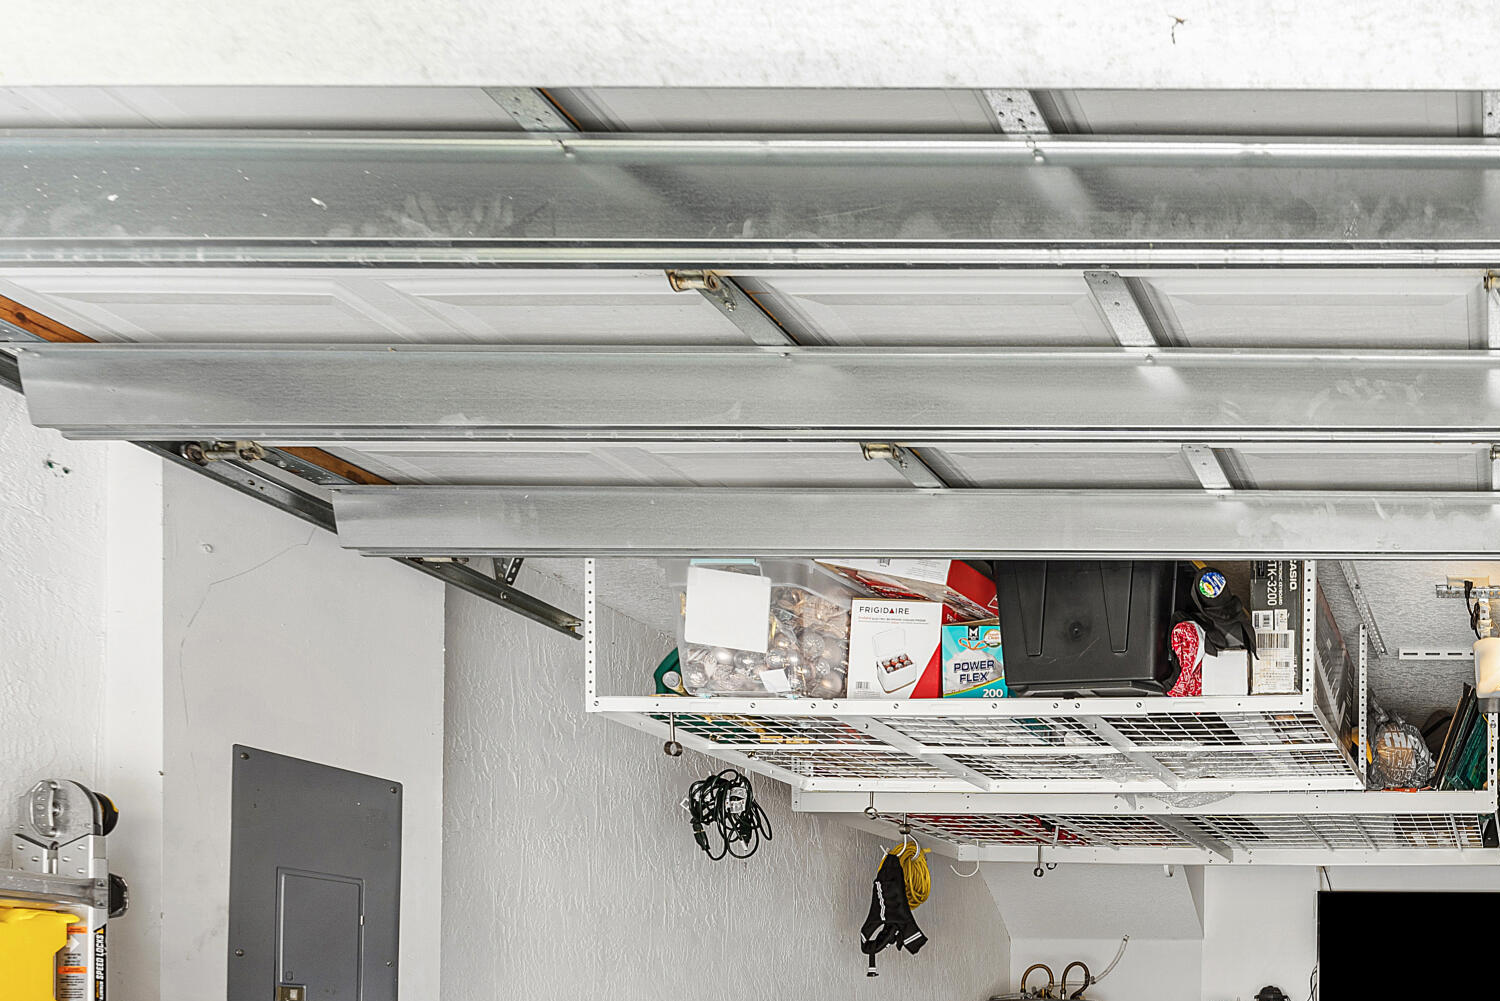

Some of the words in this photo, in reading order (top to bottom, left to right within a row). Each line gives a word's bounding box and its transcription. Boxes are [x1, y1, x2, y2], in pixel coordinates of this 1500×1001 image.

[1267, 560, 1277, 606] TK-3200
[953, 659, 995, 672] POWER
[959, 674, 987, 685] FLEX
[982, 688, 1003, 698] 200
[95, 933, 105, 957] LOCKS
[95, 956, 105, 980] SPEED
